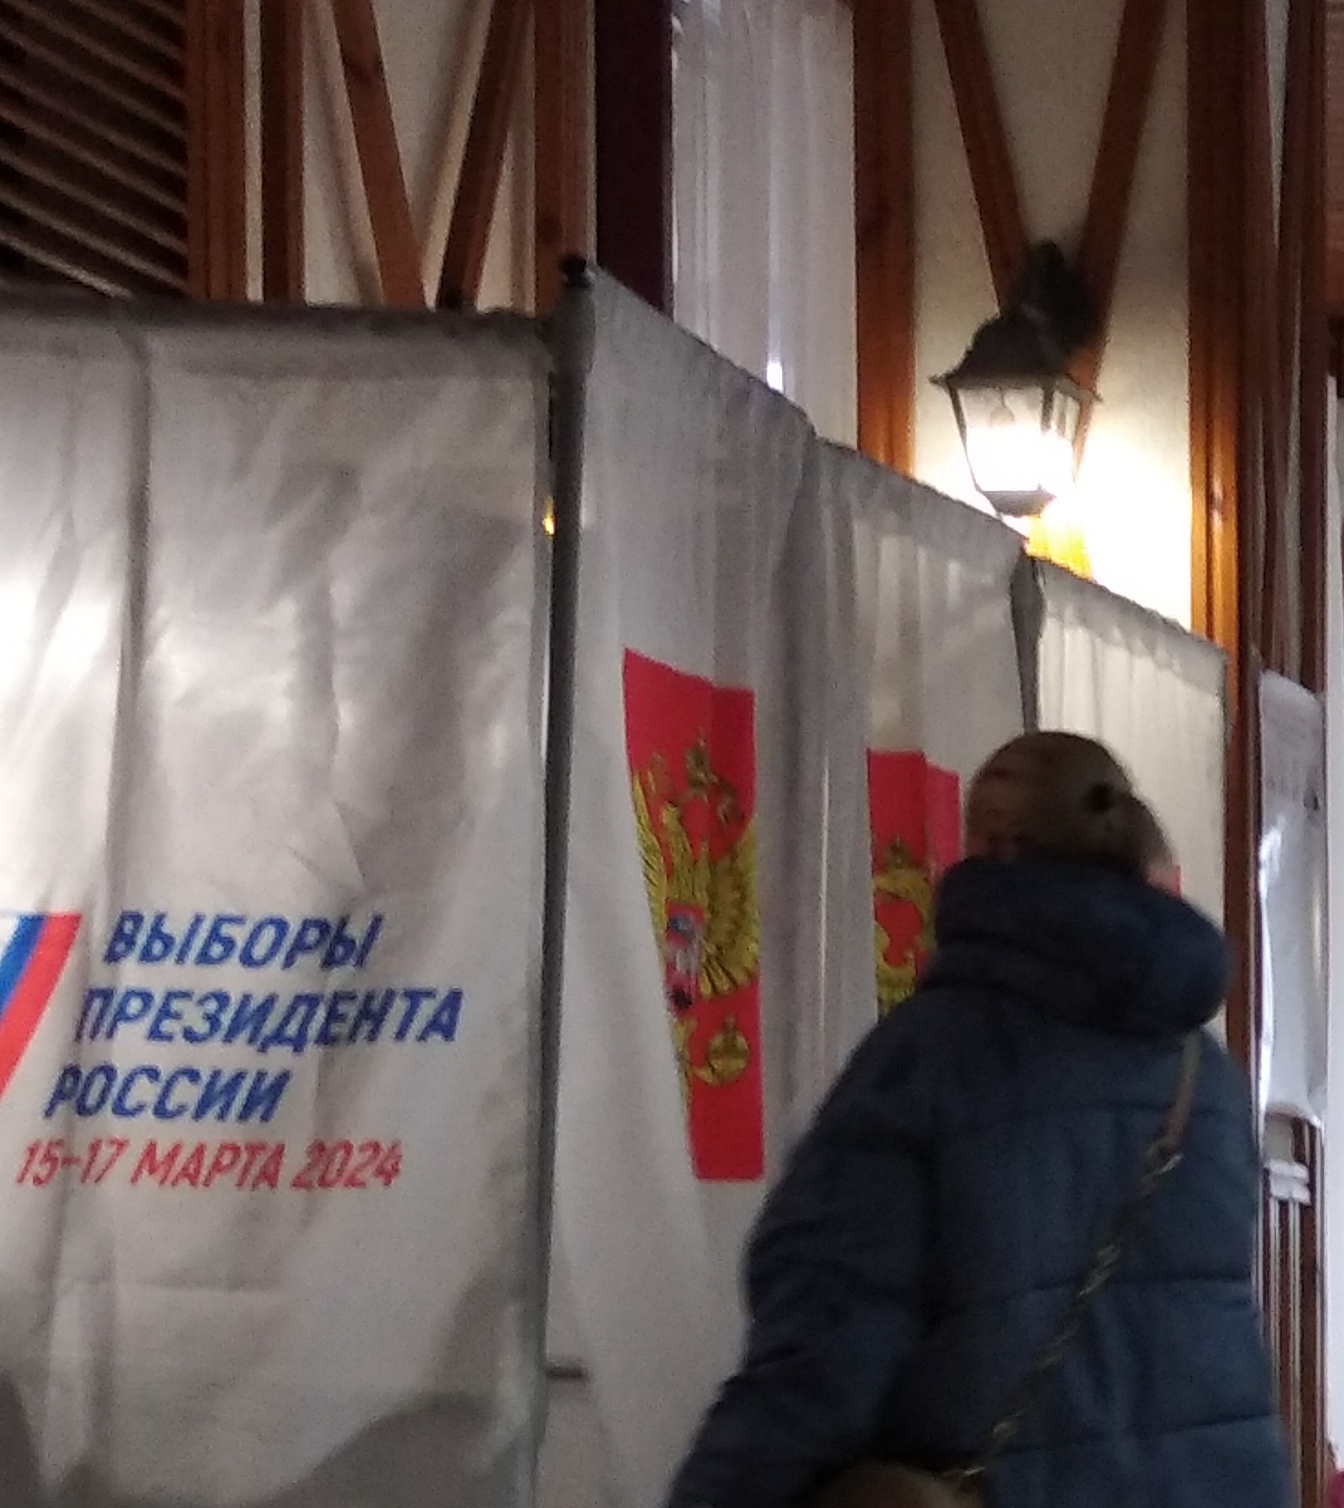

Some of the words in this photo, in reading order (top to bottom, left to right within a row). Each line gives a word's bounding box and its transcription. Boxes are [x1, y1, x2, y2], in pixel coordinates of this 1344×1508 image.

[104, 911, 385, 970] ВЫБОРЫ
[74, 987, 465, 1053] ПРЕЗИДЕНТА
[44, 1064, 291, 1121] РОССИИ
[17, 1138, 128, 1186] 15-17
[130, 1141, 287, 1189] МАРТА
[291, 1141, 404, 1190] 2024
